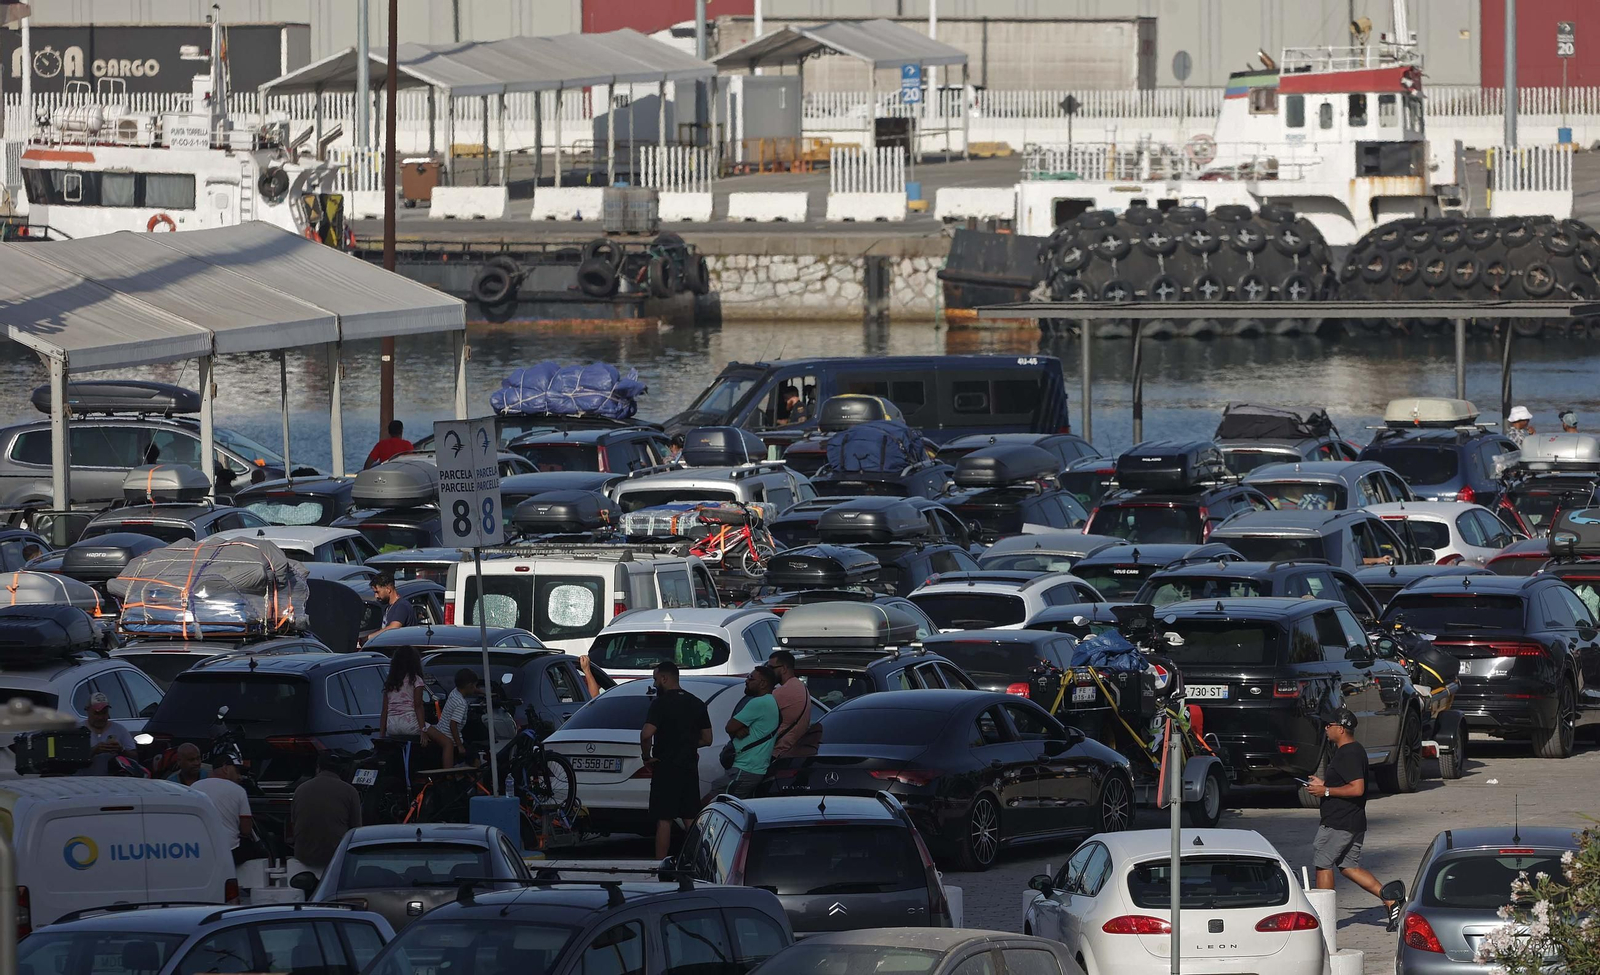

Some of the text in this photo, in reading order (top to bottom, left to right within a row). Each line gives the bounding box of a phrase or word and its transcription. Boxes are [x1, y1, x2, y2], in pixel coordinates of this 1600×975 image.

[1557, 42, 1575, 55] 20
[92, 59, 160, 77] CARGO
[903, 87, 919, 101] 20
[439, 469, 473, 480] PARCELA
[476, 465, 498, 479] PARCELA
[440, 482, 475, 492] PARCELLE
[476, 478, 499, 491] PARCELLE
[452, 499, 472, 537] 8
[482, 496, 495, 535] 8
[1184, 686, 1222, 697] -730-ST
[110, 842, 200, 861] ILUNION
